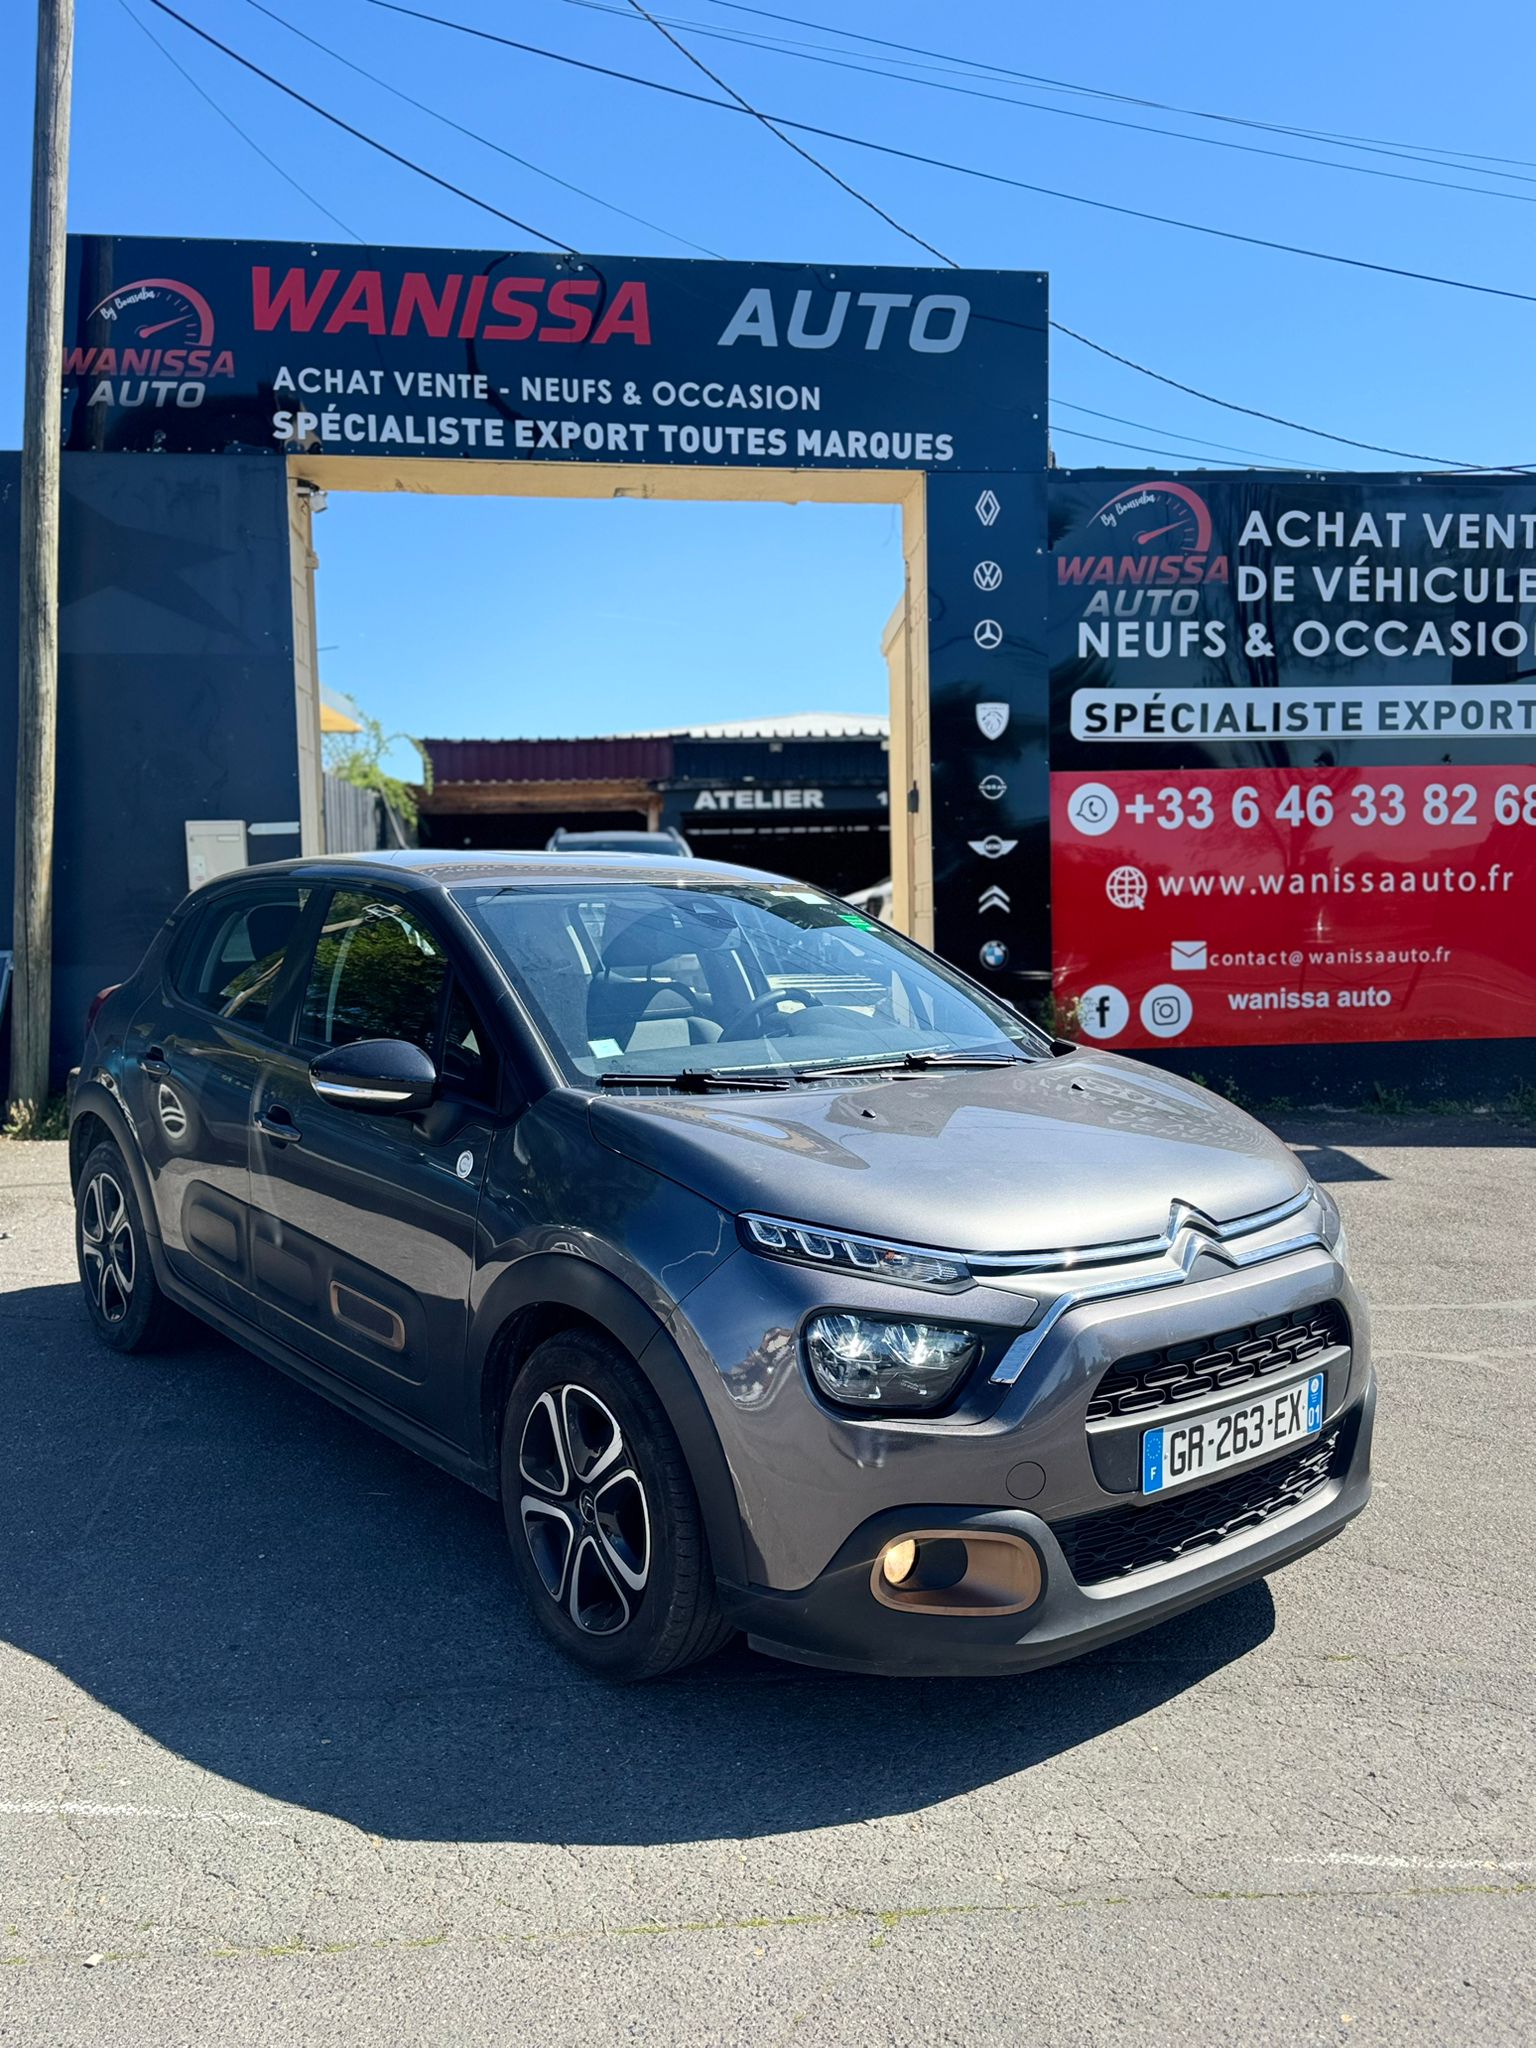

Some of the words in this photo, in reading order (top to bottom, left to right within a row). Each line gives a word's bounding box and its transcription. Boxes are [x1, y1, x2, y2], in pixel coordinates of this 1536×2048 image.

[252, 266, 652, 346] WANISSA
[717, 288, 971, 354] AUTO
[62, 347, 235, 378] WANISSA
[86, 380, 206, 408] AUTO
[273, 367, 384, 395] ACHAT
[394, 371, 488, 400] VENTE
[521, 377, 613, 405] NEUFS
[622, 381, 642, 405] &
[652, 381, 820, 411] OCCASION
[272, 404, 505, 448] SPÉCIALISTE
[515, 419, 650, 452] EXPORT
[658, 424, 787, 456] TOUTES
[797, 429, 954, 461] MARQUES
[1237, 510, 1407, 548] ACHAT
[1057, 555, 1230, 586] WANISSA
[1237, 565, 1295, 602] DE
[1312, 555, 1536, 603] VÉHICULE
[1082, 588, 1200, 618] AUTO
[1078, 621, 1227, 658] NEUFS
[1245, 622, 1276, 658] &
[1293, 620, 1536, 658] OCCASIO
[1084, 693, 1363, 734] SPÉCIALISTE
[1378, 700, 1536, 732] EXPORT
[694, 789, 824, 810] ATELIER
[1125, 786, 1215, 830] +33
[1232, 785, 1260, 829] 6
[1275, 785, 1334, 828] 46
[1350, 783, 1406, 827] 33
[1422, 783, 1478, 826] 82
[1158, 864, 1514, 897] www.wanissaauto.fr
[1228, 988, 1330, 1010] wanissa
[1337, 986, 1392, 1008] auto
[1150, 1466, 1157, 1480] F
[1169, 1389, 1303, 1477] GR-263-EX
[1308, 1404, 1320, 1427] 01
